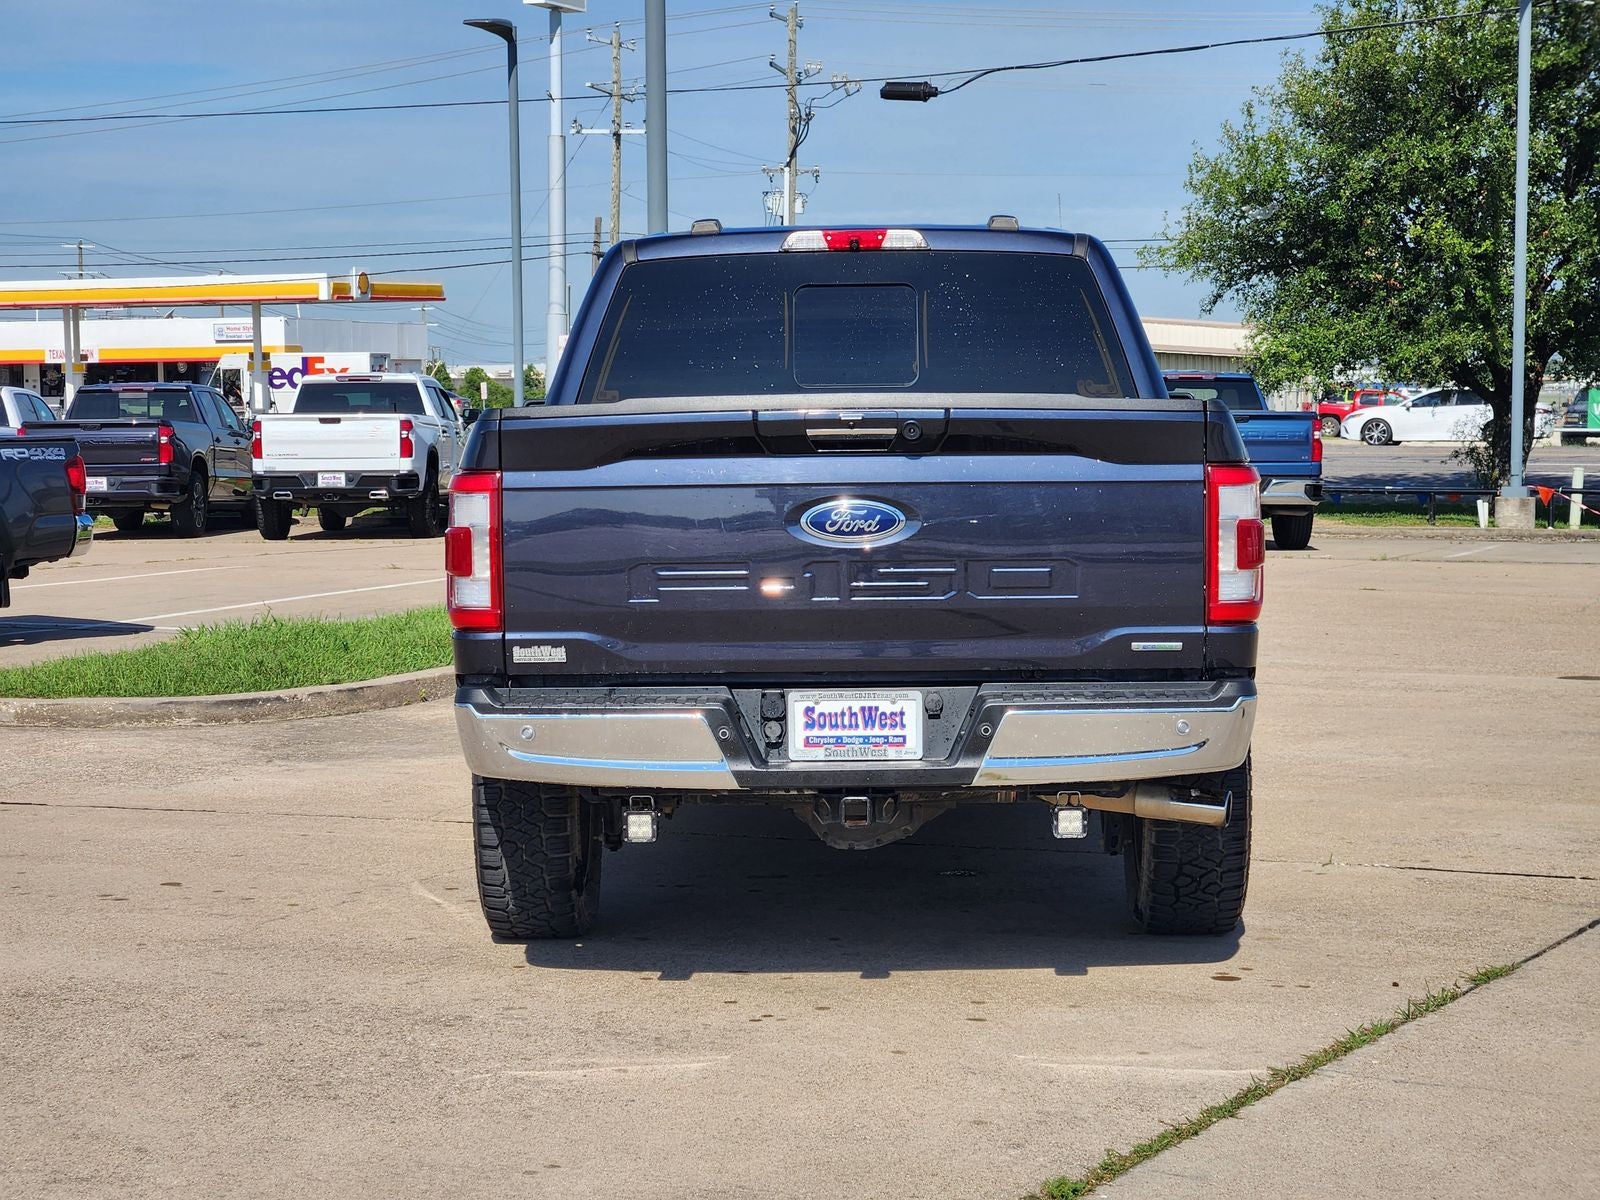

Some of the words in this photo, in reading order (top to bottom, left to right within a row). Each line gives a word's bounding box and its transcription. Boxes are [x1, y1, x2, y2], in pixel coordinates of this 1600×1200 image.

[0, 448, 30, 460] RD
[825, 509, 881, 532] Ford
[512, 645, 567, 656] SouthWest
[803, 706, 907, 731] SouthWest
[808, 736, 837, 744] Chrysler
[842, 736, 864, 744] Dodge
[868, 736, 885, 744] Jeep
[888, 736, 904, 744] Ram
[824, 747, 889, 758] SouthWest
